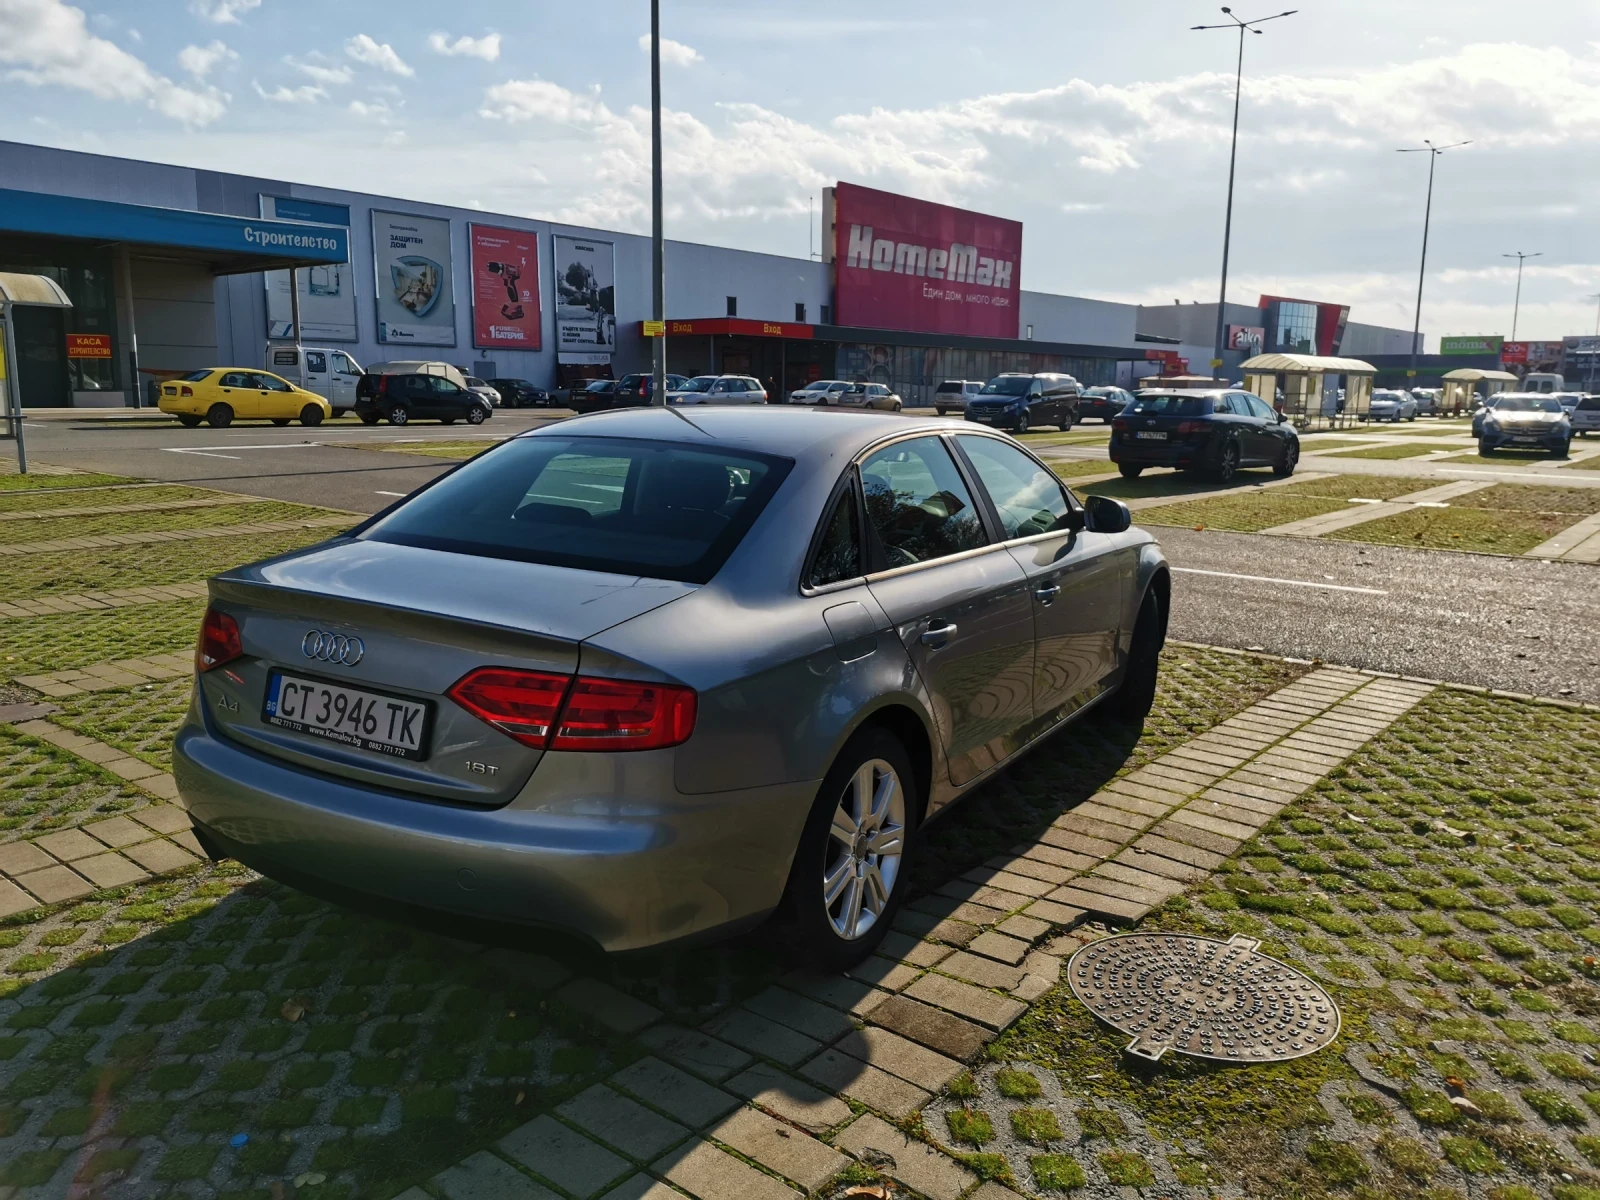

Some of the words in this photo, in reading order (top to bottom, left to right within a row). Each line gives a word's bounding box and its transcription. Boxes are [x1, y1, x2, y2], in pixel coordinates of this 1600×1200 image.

[244, 226, 337, 250] Строителство
[390, 234, 423, 244] ЗАЩИТЕН
[390, 241, 407, 249] ДОМ
[847, 224, 1013, 289] HomeMax
[923, 282, 943, 300] Един
[945, 290, 964, 304] дом,
[966, 293, 989, 305] много
[673, 322, 692, 333] Вход
[764, 323, 782, 335] Вход
[76, 337, 102, 346] КАСА
[69, 347, 111, 355] СТРОИТЕЛСТВО
[217, 694, 239, 713] A4
[266, 701, 277, 712] BG
[281, 682, 314, 721] CT
[315, 689, 377, 735] 3946
[387, 702, 420, 745] TK
[283, 719, 292, 729] 771
[309, 726, 362, 747] www.Kemalov.bg
[368, 741, 382, 751] 0882
[383, 744, 393, 754] 771
[394, 746, 405, 756] 772
